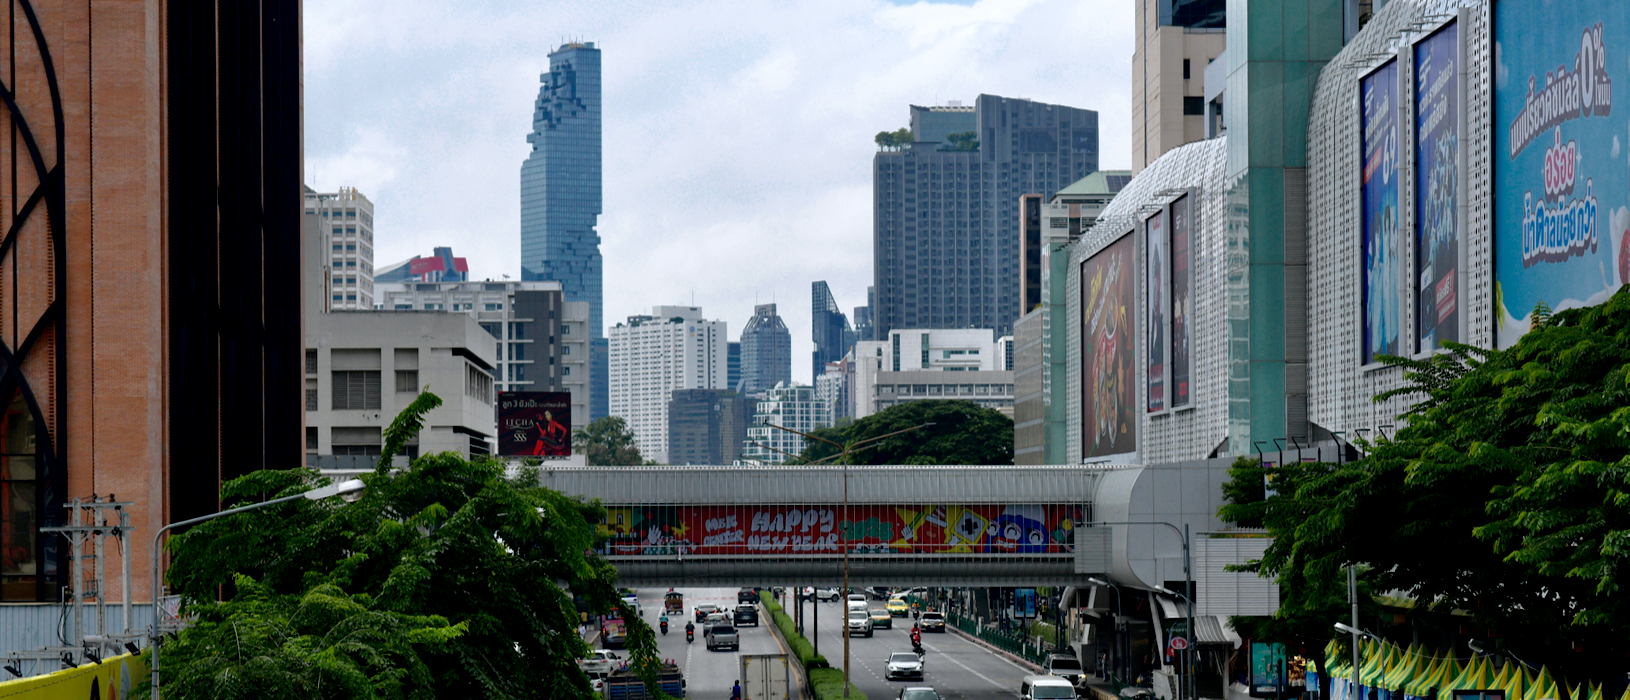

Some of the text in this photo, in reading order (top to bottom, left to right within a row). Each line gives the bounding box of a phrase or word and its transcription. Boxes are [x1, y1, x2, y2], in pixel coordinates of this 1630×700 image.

[1545, 127, 1576, 193] อร่อย
[705, 516, 738, 533] MBK
[751, 509, 835, 533] HAPPY
[839, 517, 895, 541] 2025
[703, 530, 745, 548] CENTER
[747, 533, 839, 552] NEW YEAR
